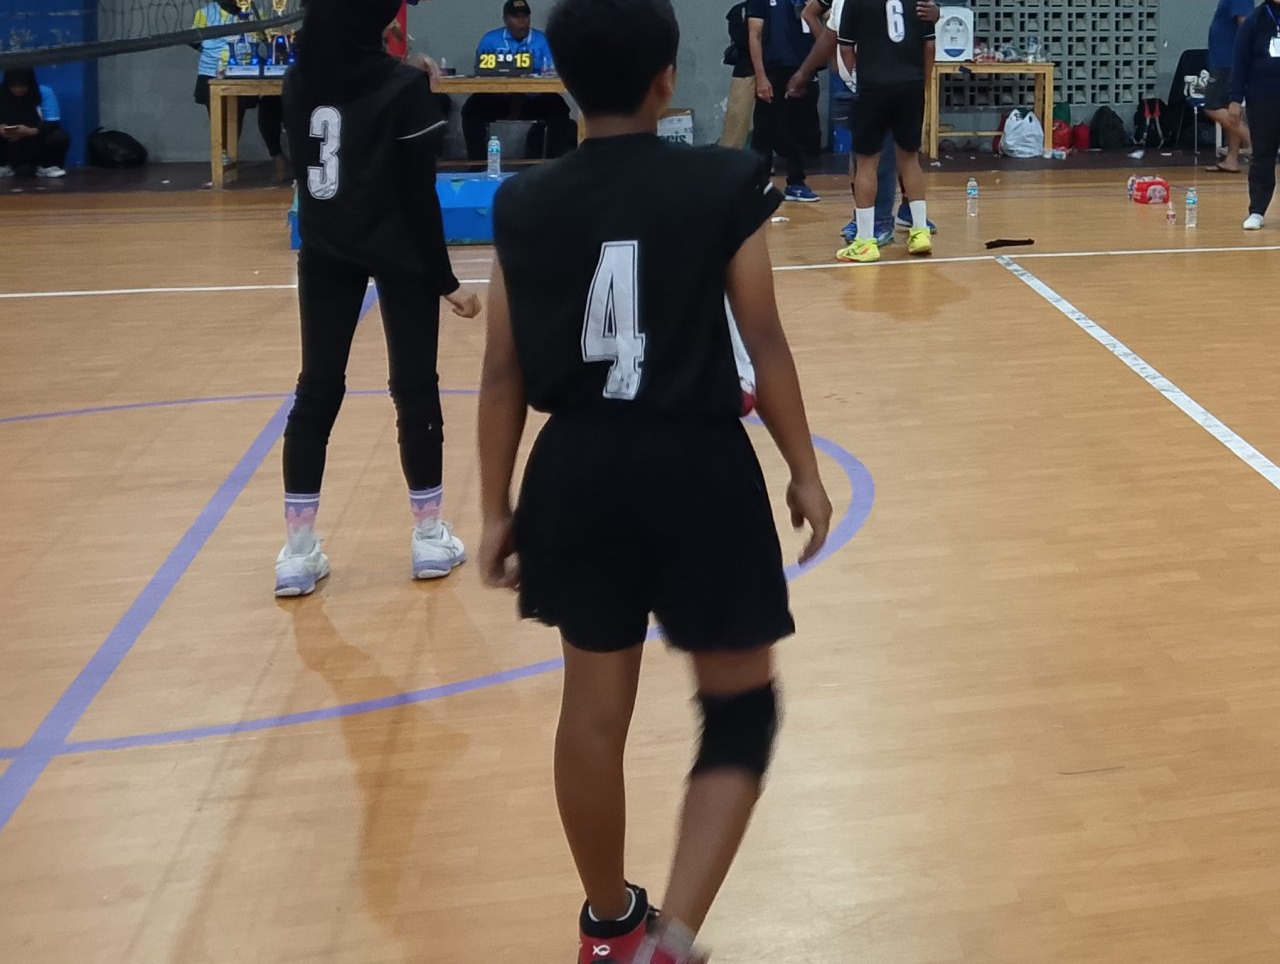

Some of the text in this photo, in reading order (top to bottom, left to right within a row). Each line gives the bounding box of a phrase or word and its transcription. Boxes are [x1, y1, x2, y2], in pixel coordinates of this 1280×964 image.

[479, 53, 496, 69] 28
[505, 54, 513, 62] 0
[514, 53, 530, 68] 15
[307, 105, 342, 200] 3
[581, 240, 646, 401] 4
